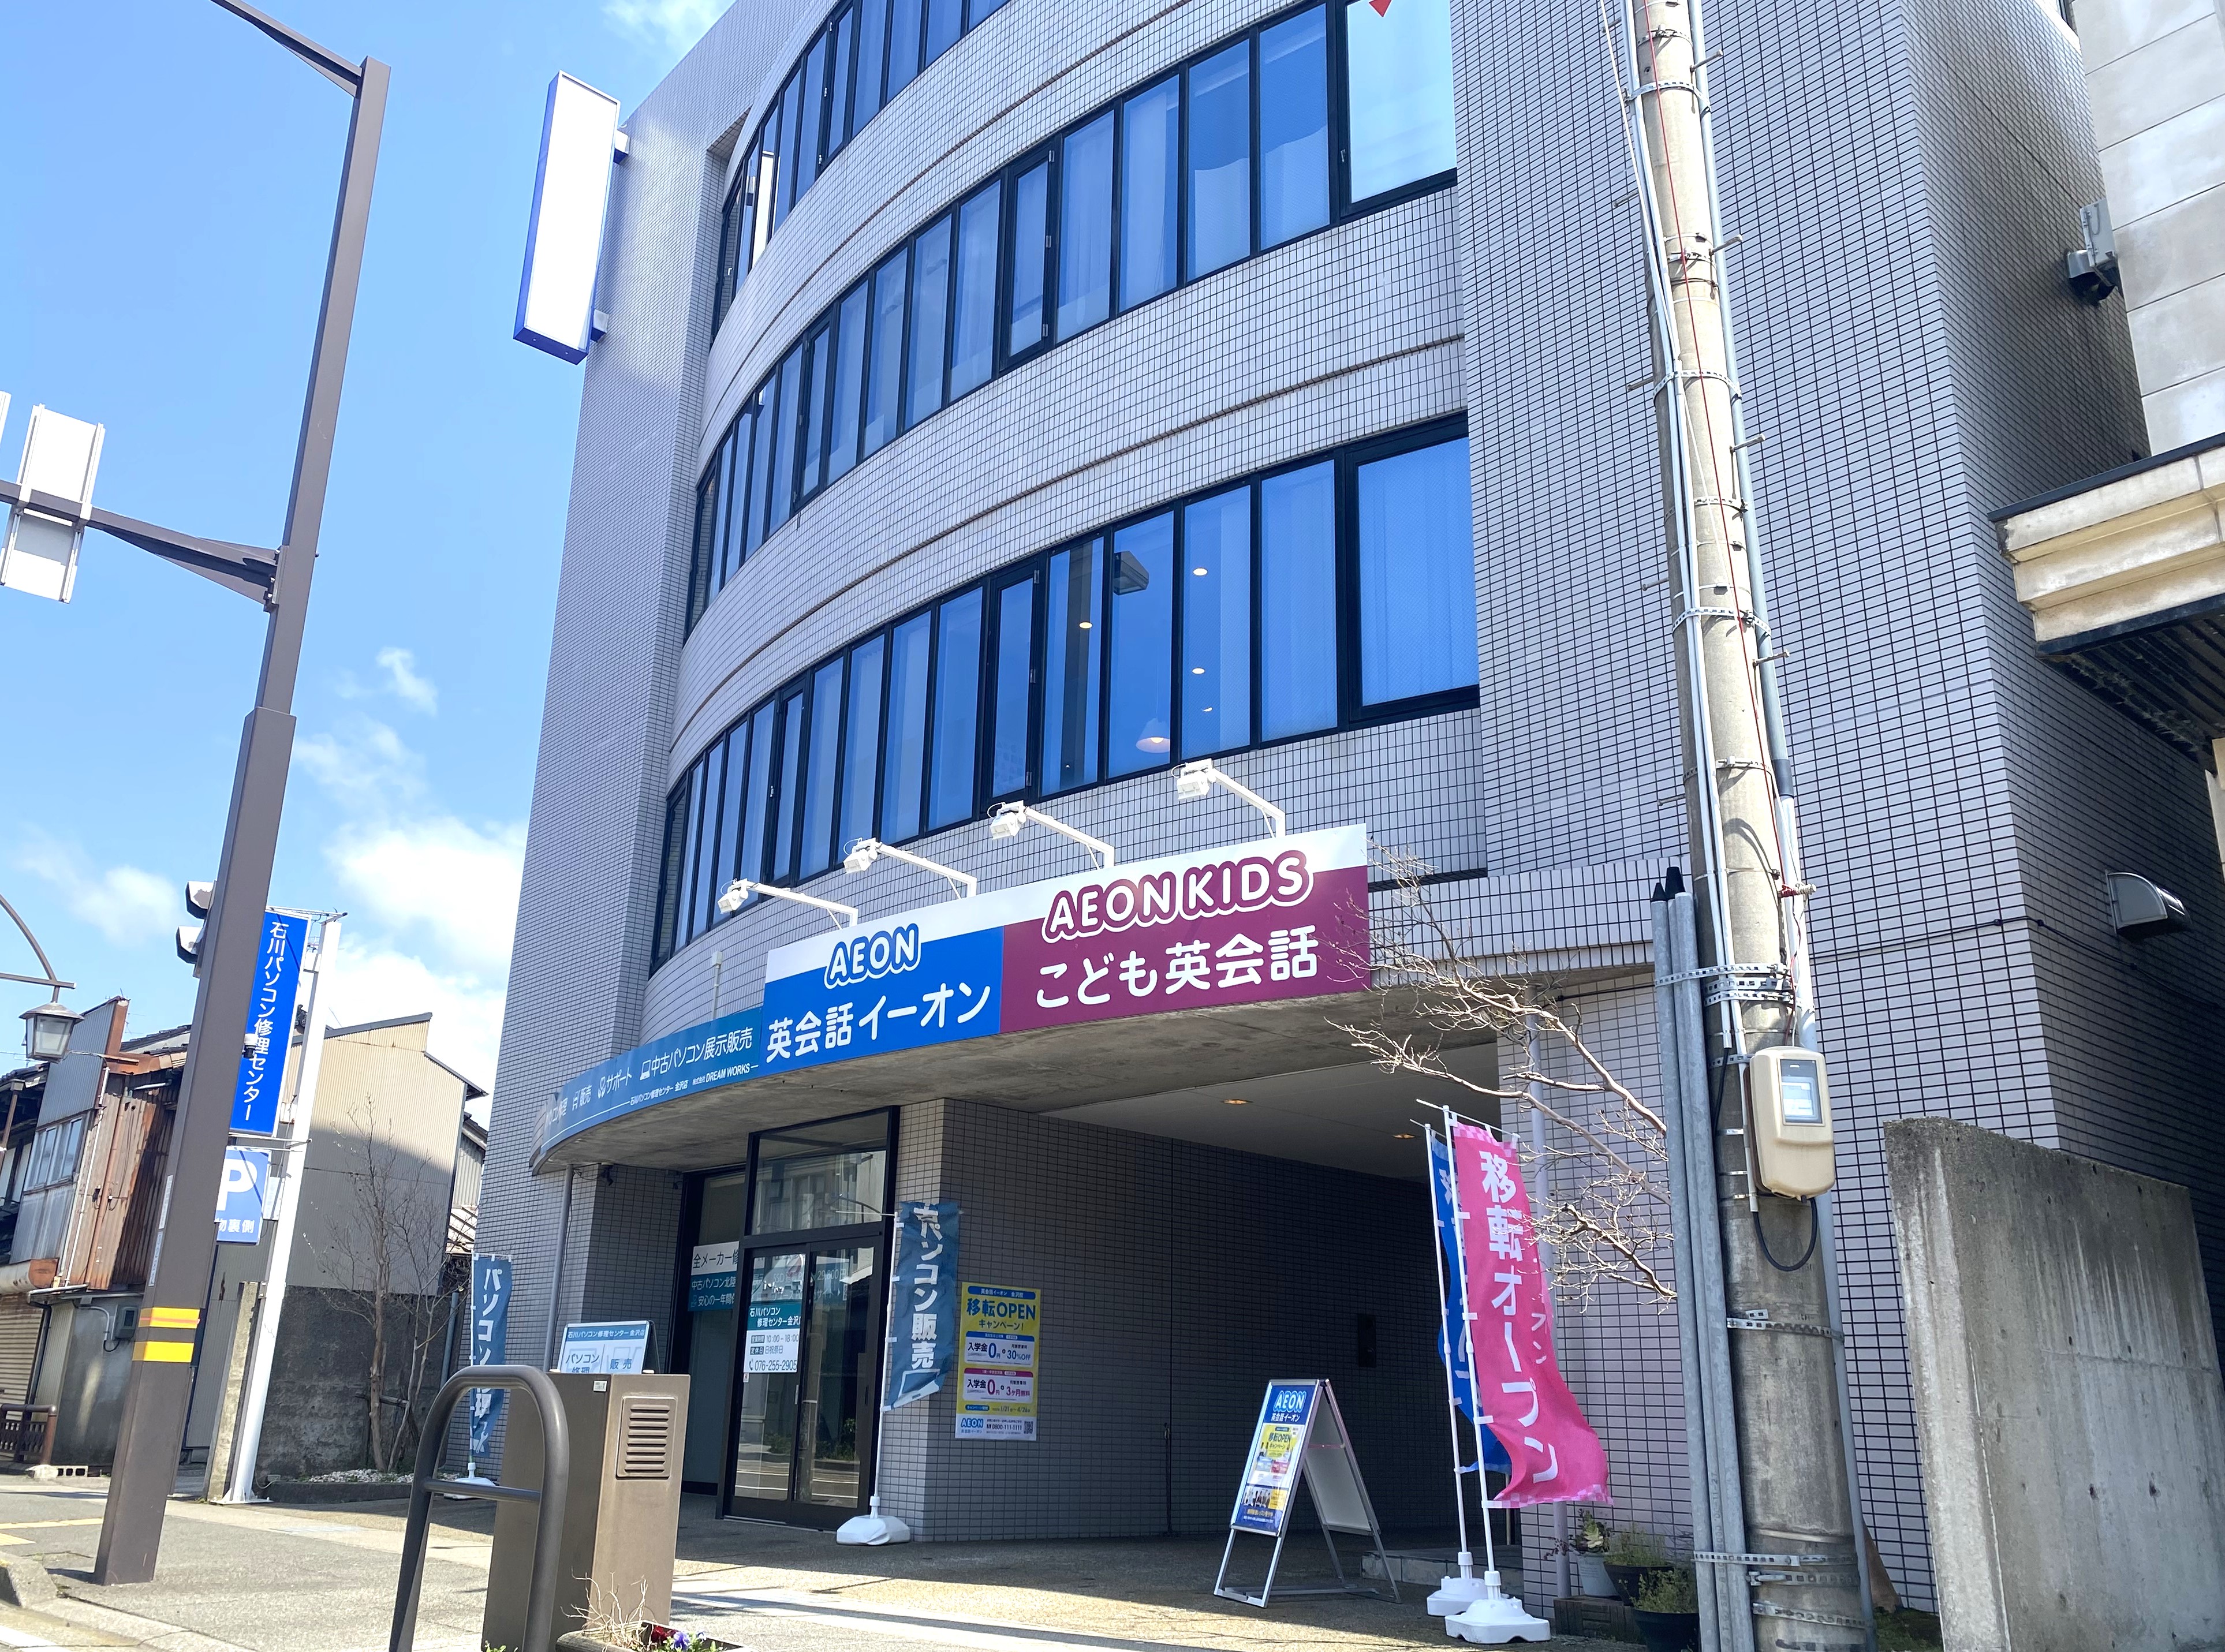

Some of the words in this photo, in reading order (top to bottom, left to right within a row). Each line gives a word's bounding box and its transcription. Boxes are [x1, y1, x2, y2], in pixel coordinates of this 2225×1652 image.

[1047, 873, 1173, 939] AEON
[1186, 853, 1310, 914] KIDS
[826, 927, 918, 985] AEON
[1037, 924, 1319, 1009] こども英会話
[765, 982, 991, 1063] 英会話イーオン
[651, 1027, 753, 1077] 中古パソコン展示販売
[606, 1067, 632, 1094] サポート
[705, 1068, 726, 1083] DREAM
[727, 1063, 750, 1077] WORKS
[216, 1158, 257, 1211] P
[750, 1307, 781, 1317] 石川パソコン
[966, 1298, 1036, 1321] 移転OPEN
[1480, 1151, 1559, 1483] 移転オープン
[566, 1354, 600, 1364] パソコン
[610, 1358, 632, 1369] 販売
[755, 1360, 797, 1371] 076-255-2905
[1274, 1392, 1306, 1412] AEON
[961, 1418, 984, 1428] AEON
